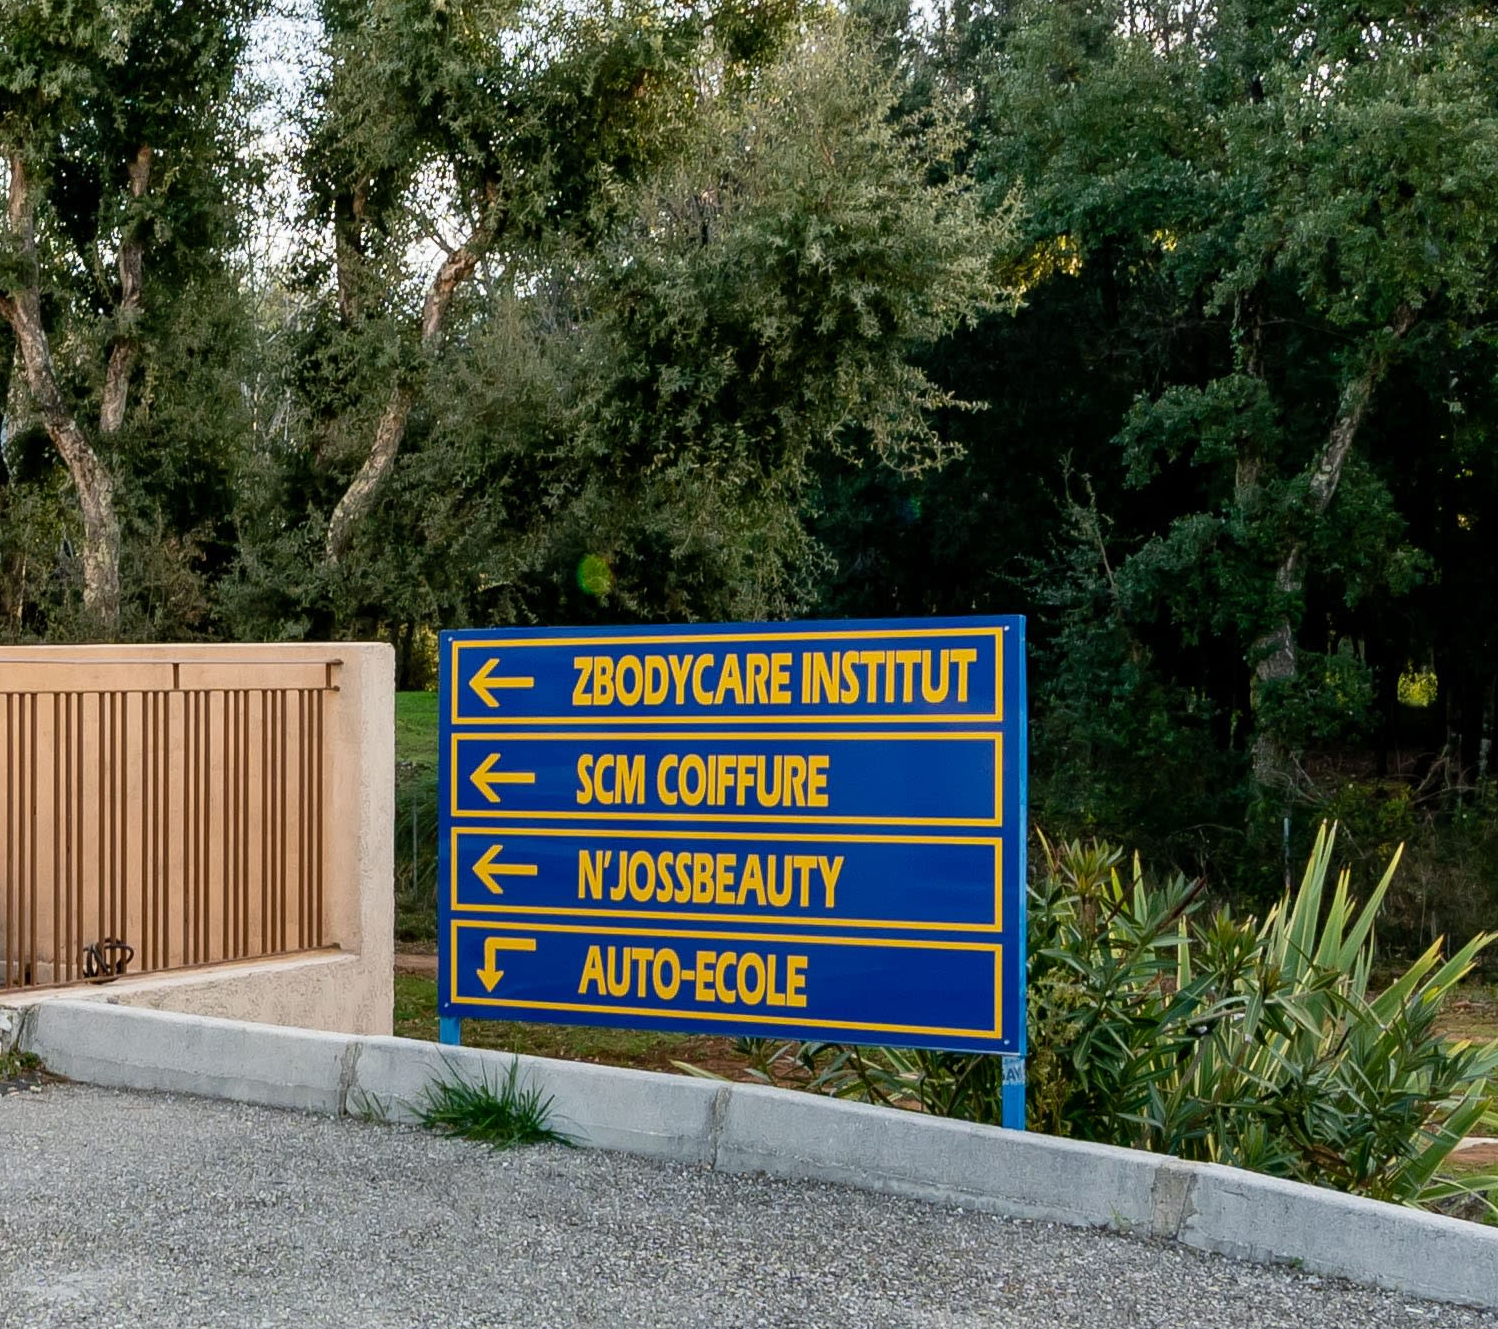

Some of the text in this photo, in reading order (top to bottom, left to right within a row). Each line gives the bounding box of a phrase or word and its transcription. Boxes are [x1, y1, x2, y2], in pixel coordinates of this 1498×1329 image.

[572, 648, 978, 707] ZBODYCARE INSTITUT
[576, 753, 830, 808] SCM COIFFURE
[577, 849, 844, 909] N'JOSSBEAUTY
[577, 945, 809, 1008] AUTO-ECOLE
